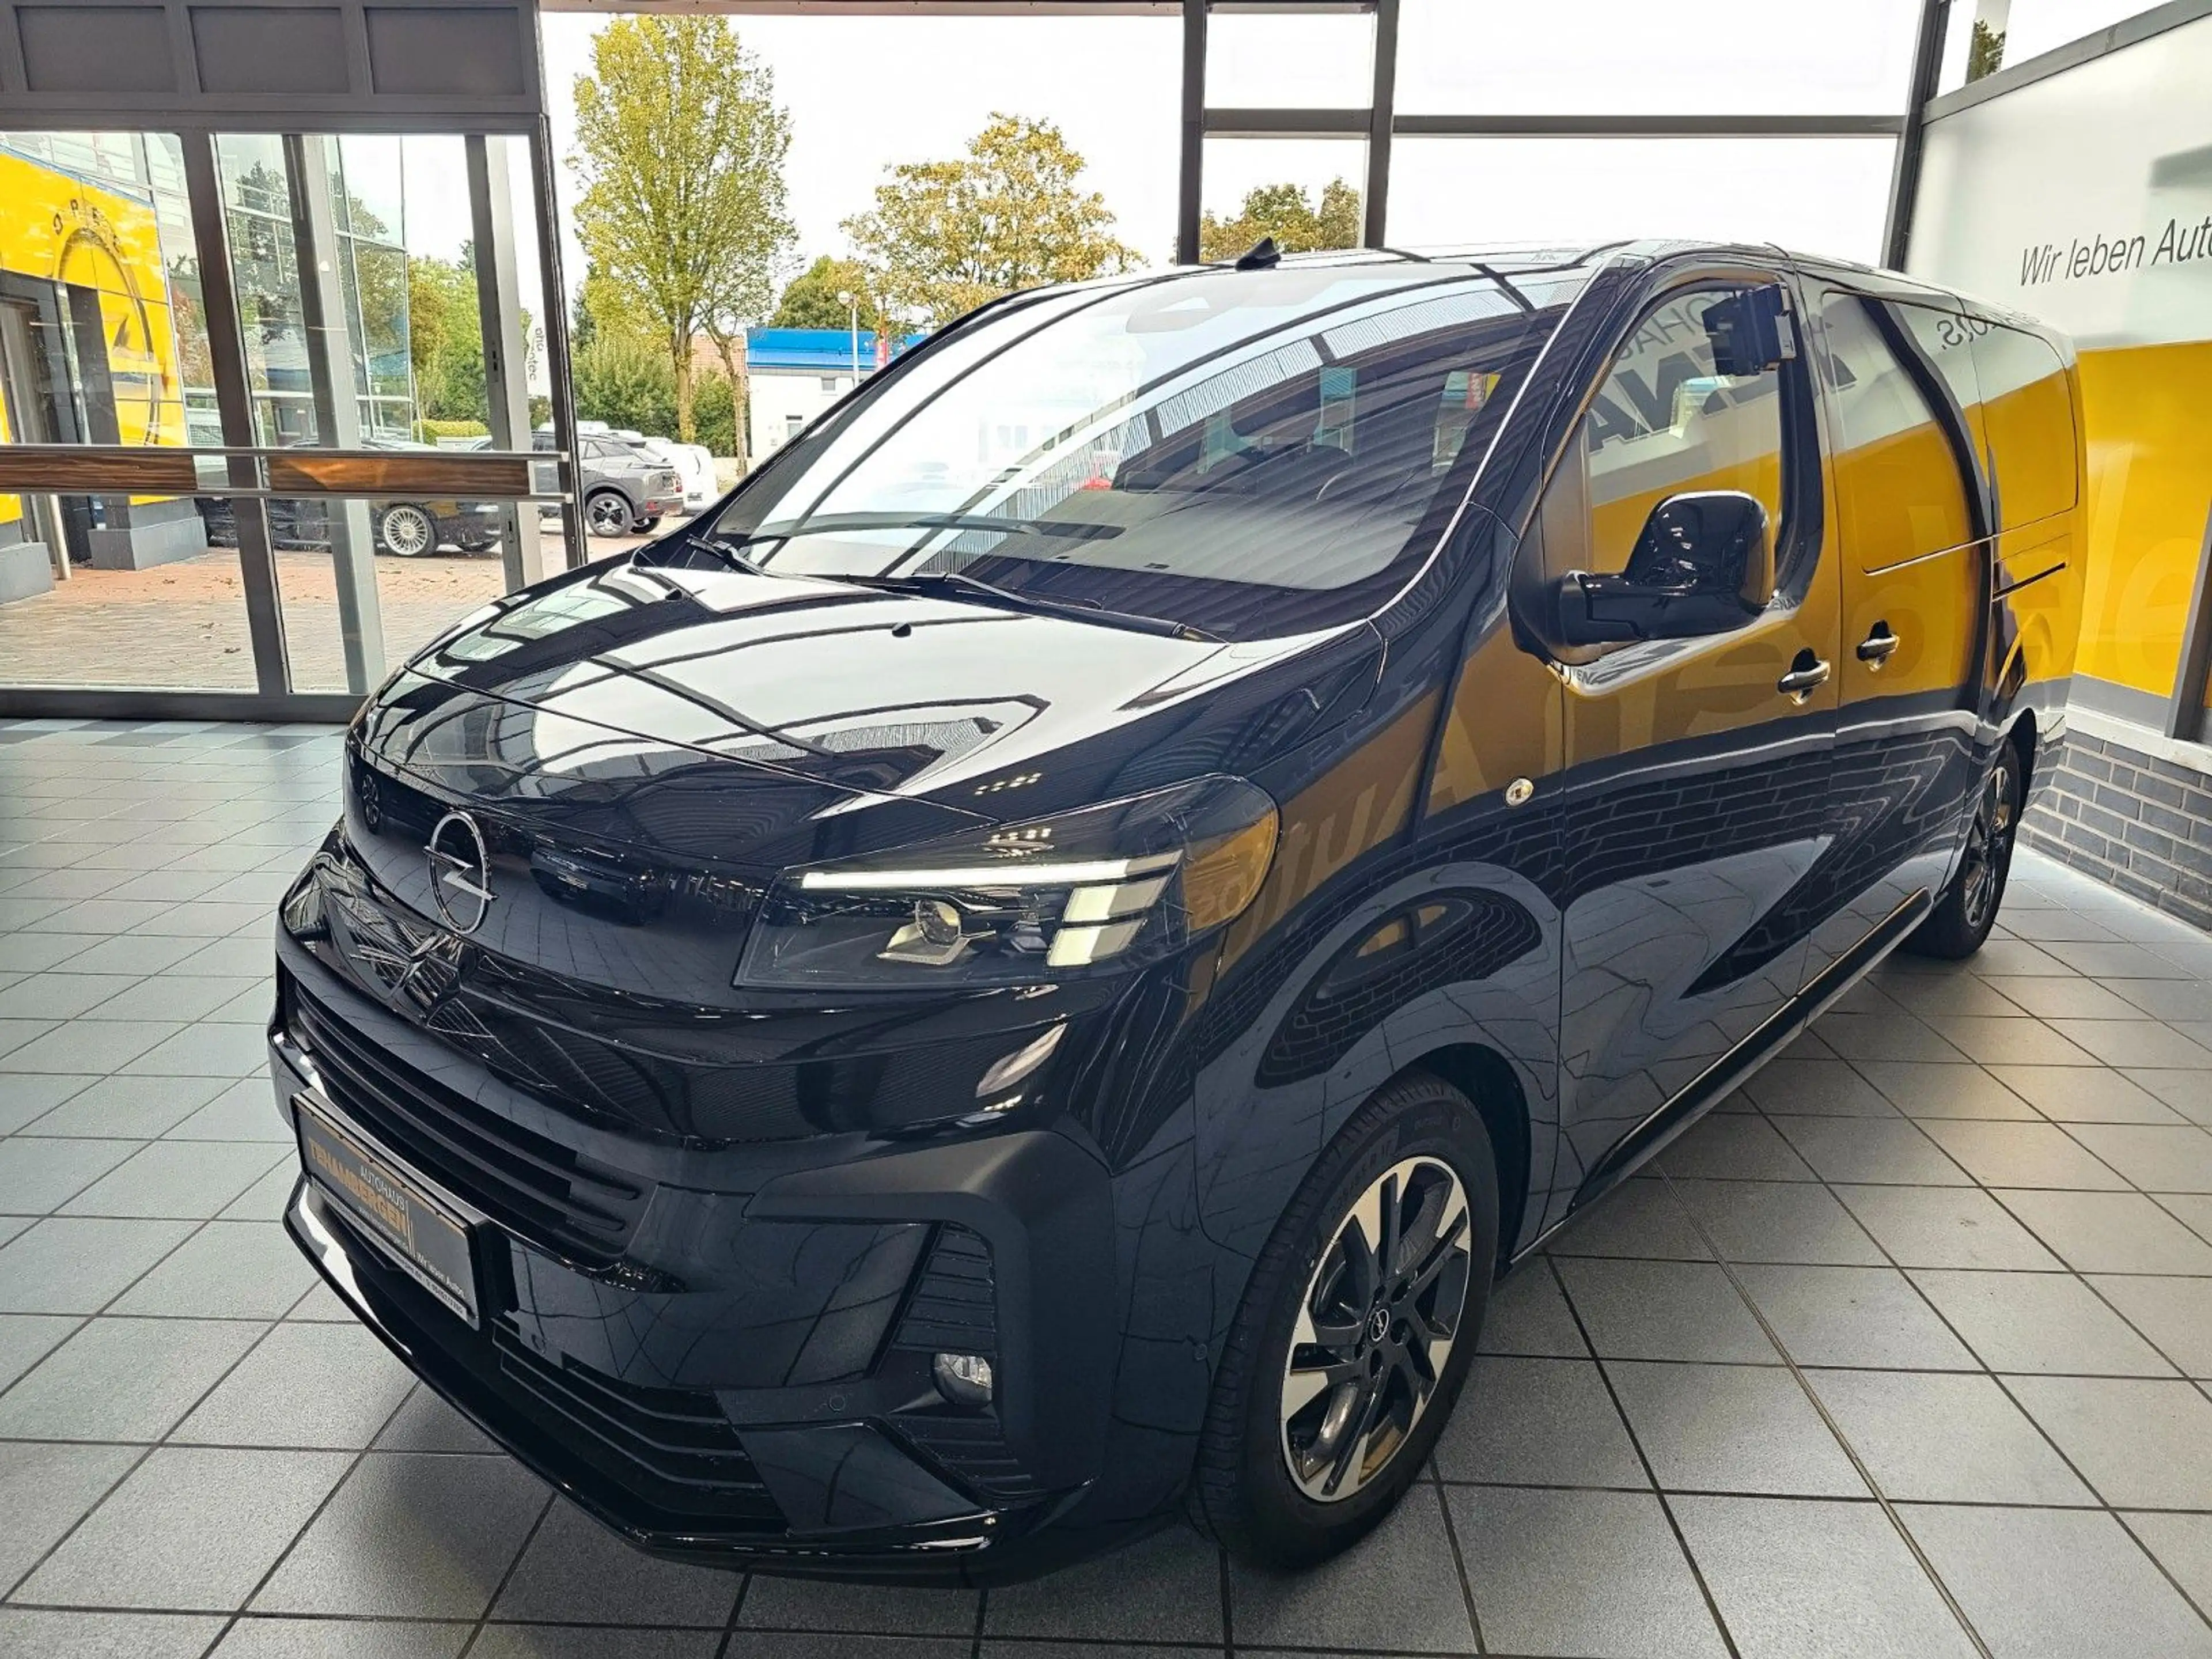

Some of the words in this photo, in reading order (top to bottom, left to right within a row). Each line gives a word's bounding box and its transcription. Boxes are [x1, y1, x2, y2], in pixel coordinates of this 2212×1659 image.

[2020, 244, 2062, 287] Wir
[2065, 233, 2145, 280] leben
[360, 1165, 405, 1211] AUTOHAUS
